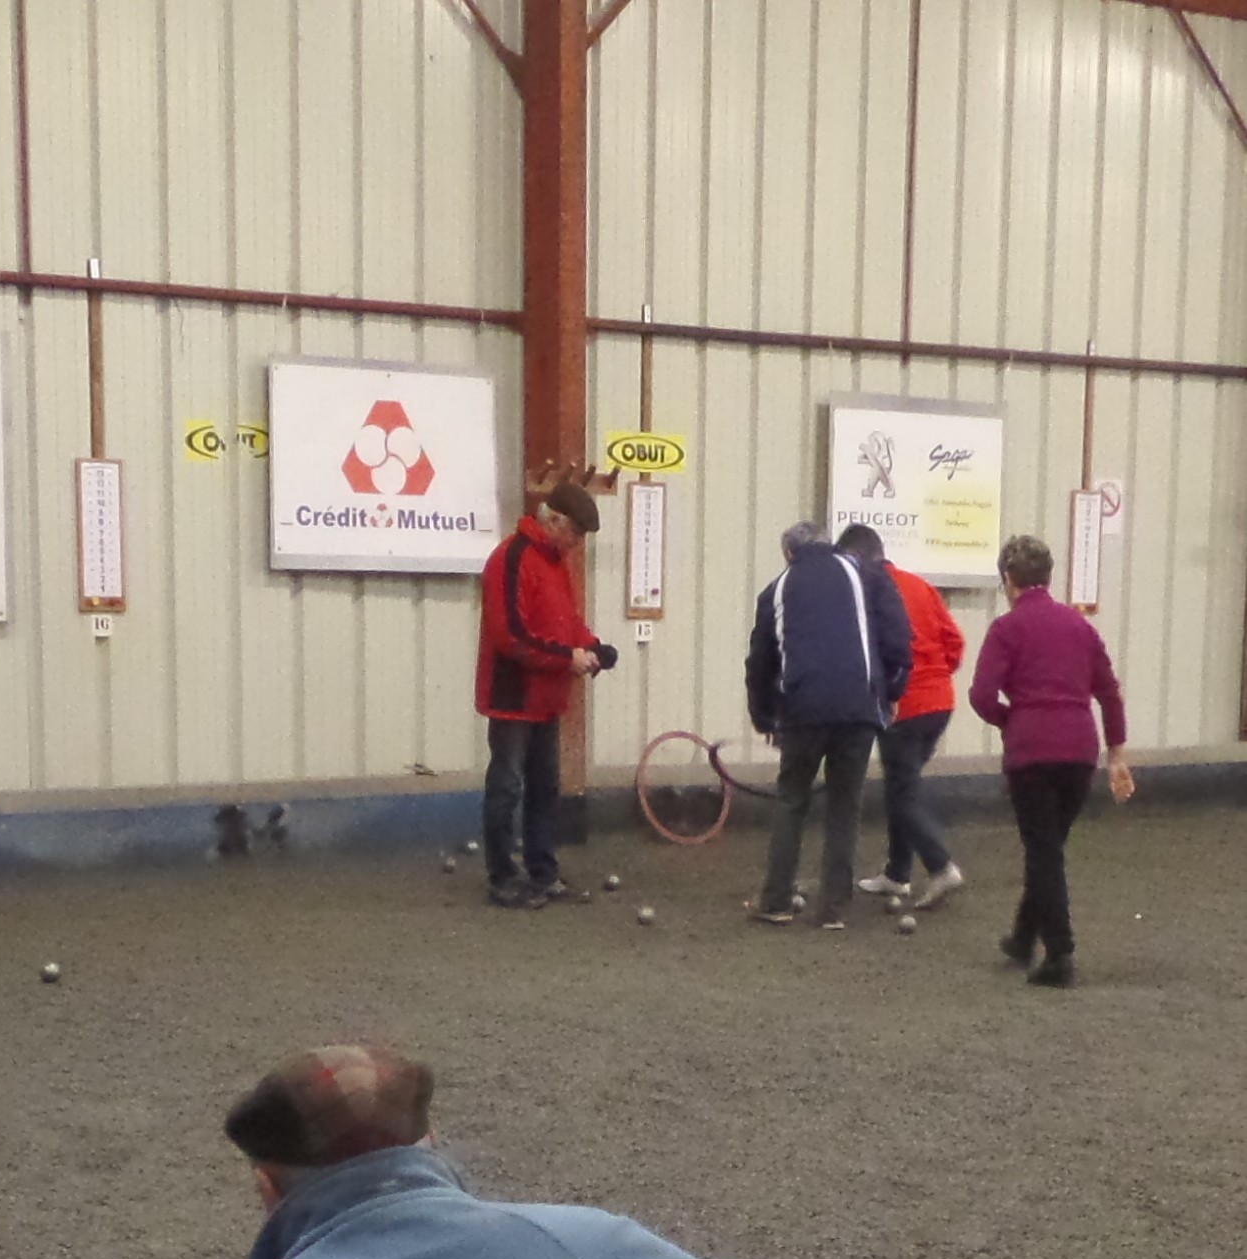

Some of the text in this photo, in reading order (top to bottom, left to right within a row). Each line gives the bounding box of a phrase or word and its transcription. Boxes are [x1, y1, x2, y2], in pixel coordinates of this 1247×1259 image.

[622, 443, 666, 463] OBUT
[296, 505, 476, 531] Crédit Mutuel
[837, 511, 919, 527] PEUGEOT
[639, 624, 651, 636] 15
